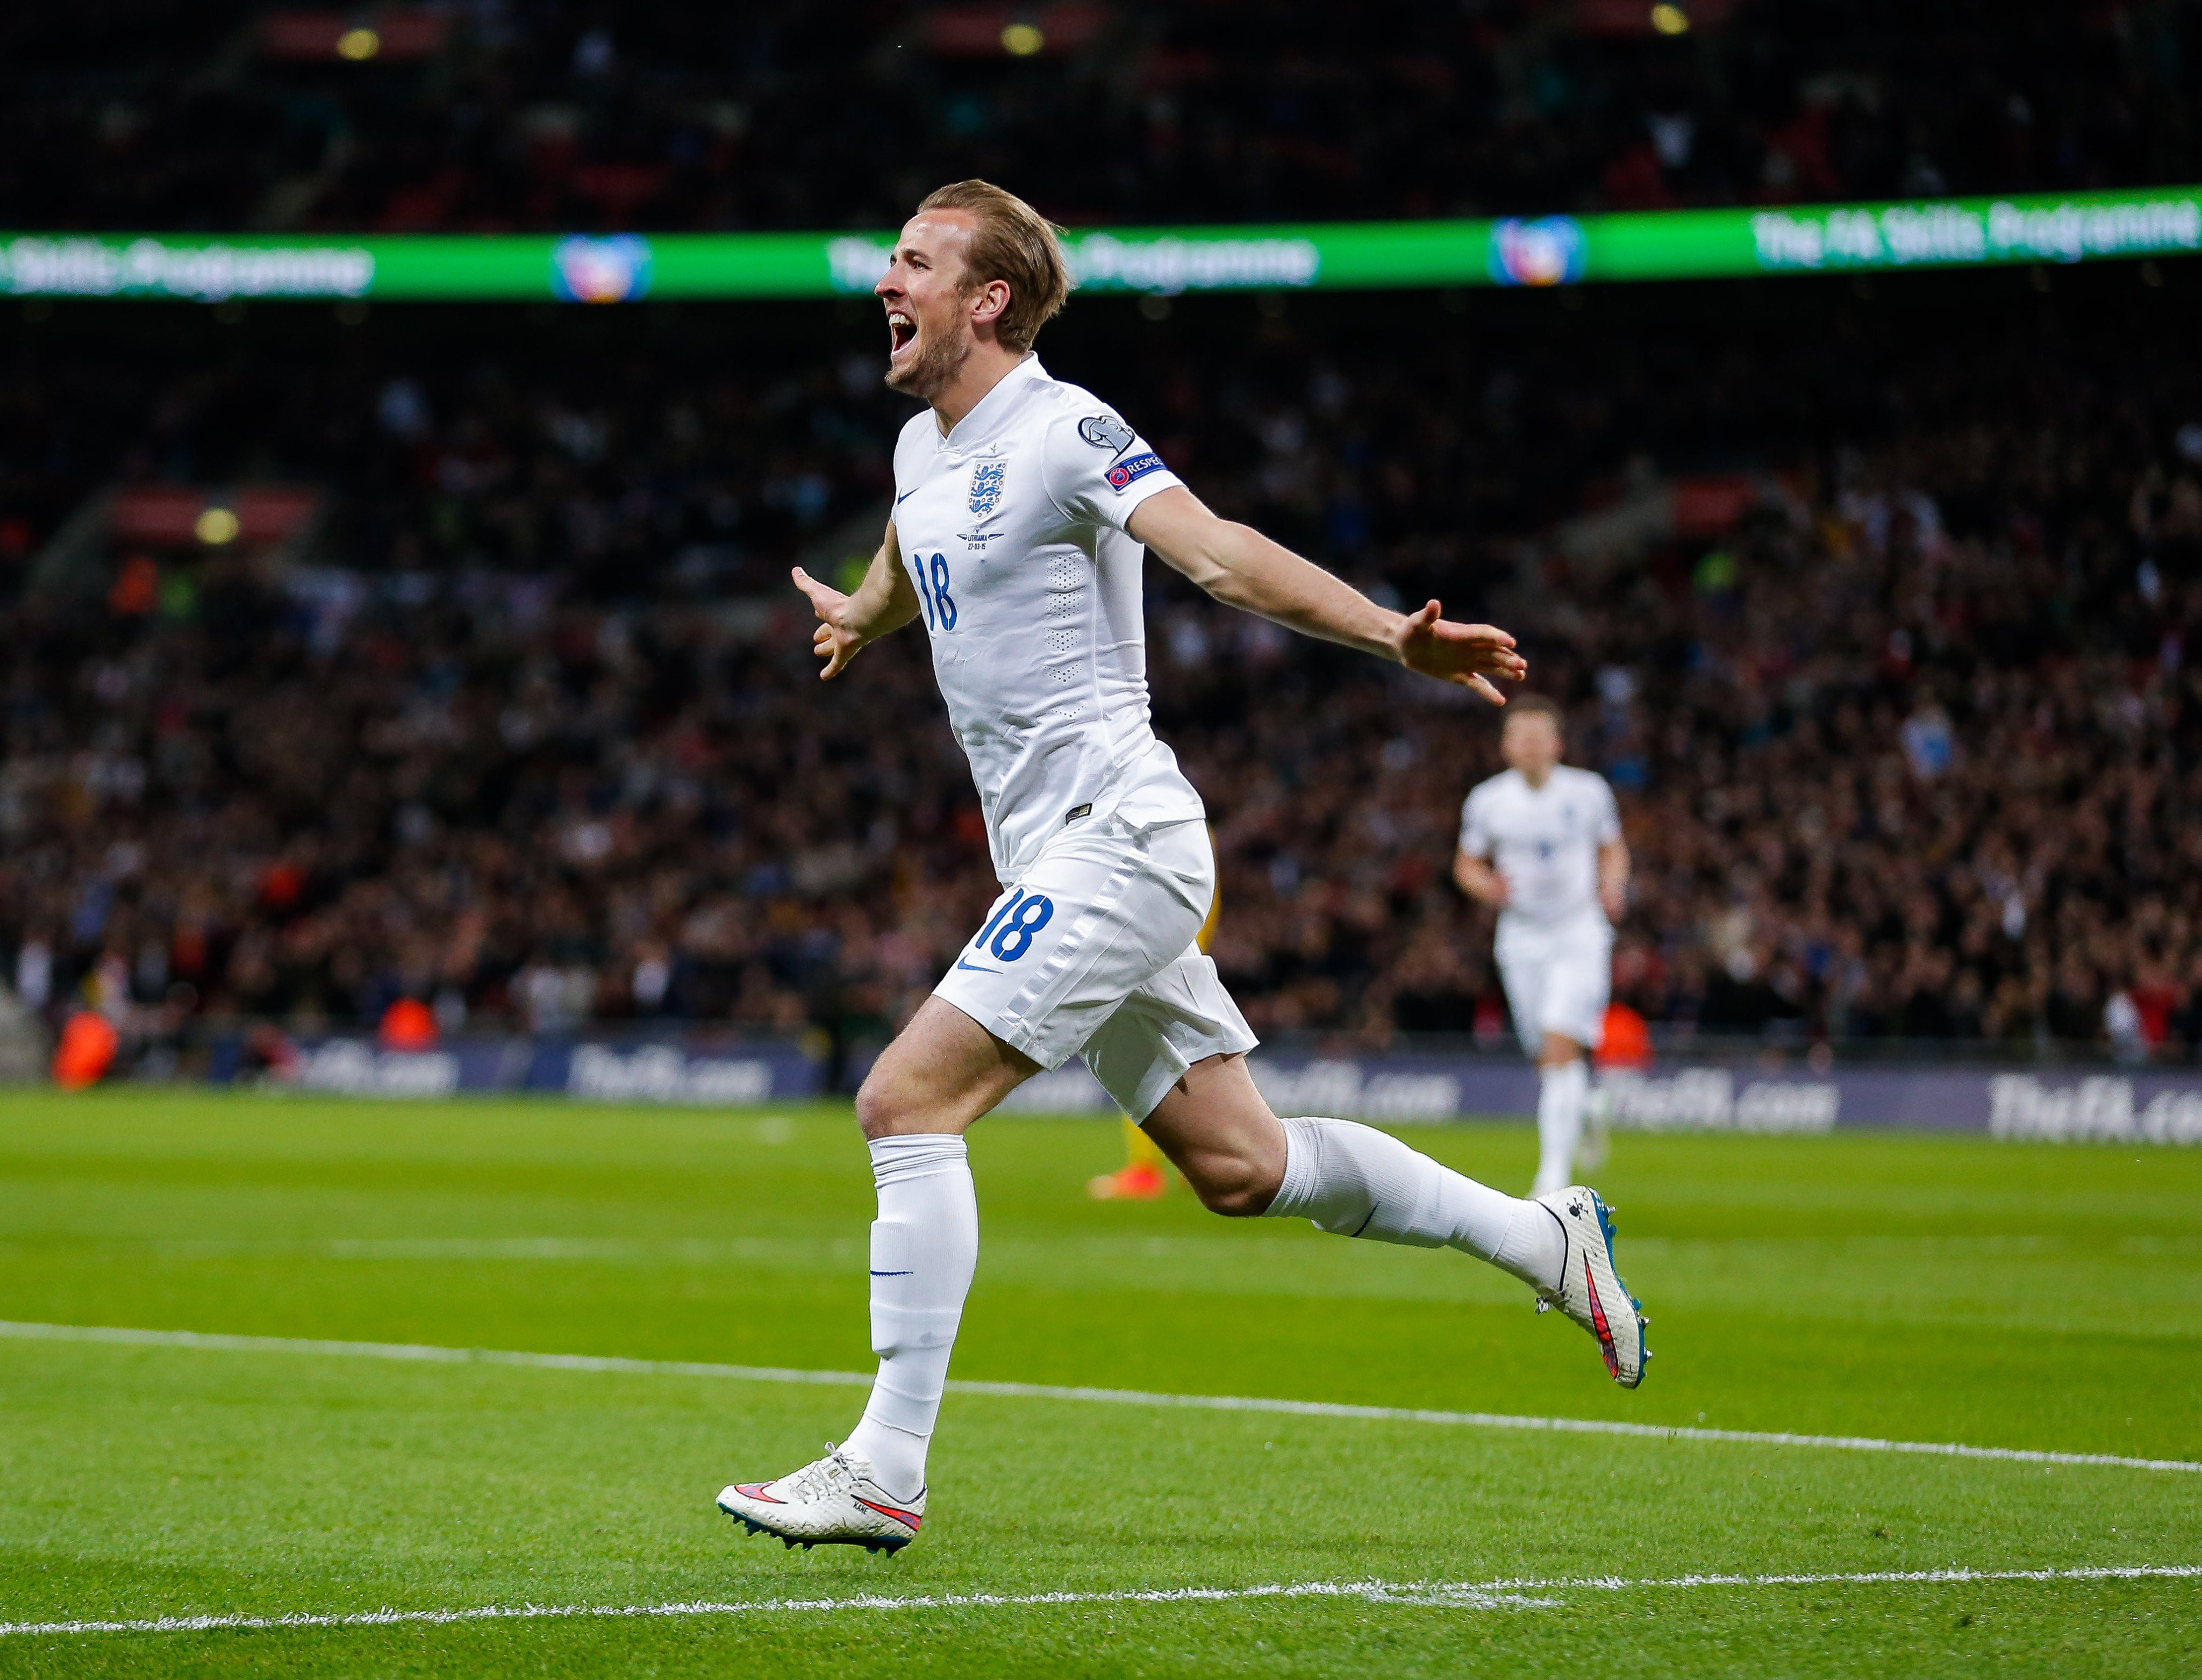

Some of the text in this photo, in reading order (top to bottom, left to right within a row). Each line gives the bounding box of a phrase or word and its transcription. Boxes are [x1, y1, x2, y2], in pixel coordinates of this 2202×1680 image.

[1751, 211, 1826, 270] The
[1989, 200, 2200, 262] Programme
[1127, 456, 1163, 474] RESPEC
[914, 553, 957, 631] 18
[975, 888, 1054, 962] 18
